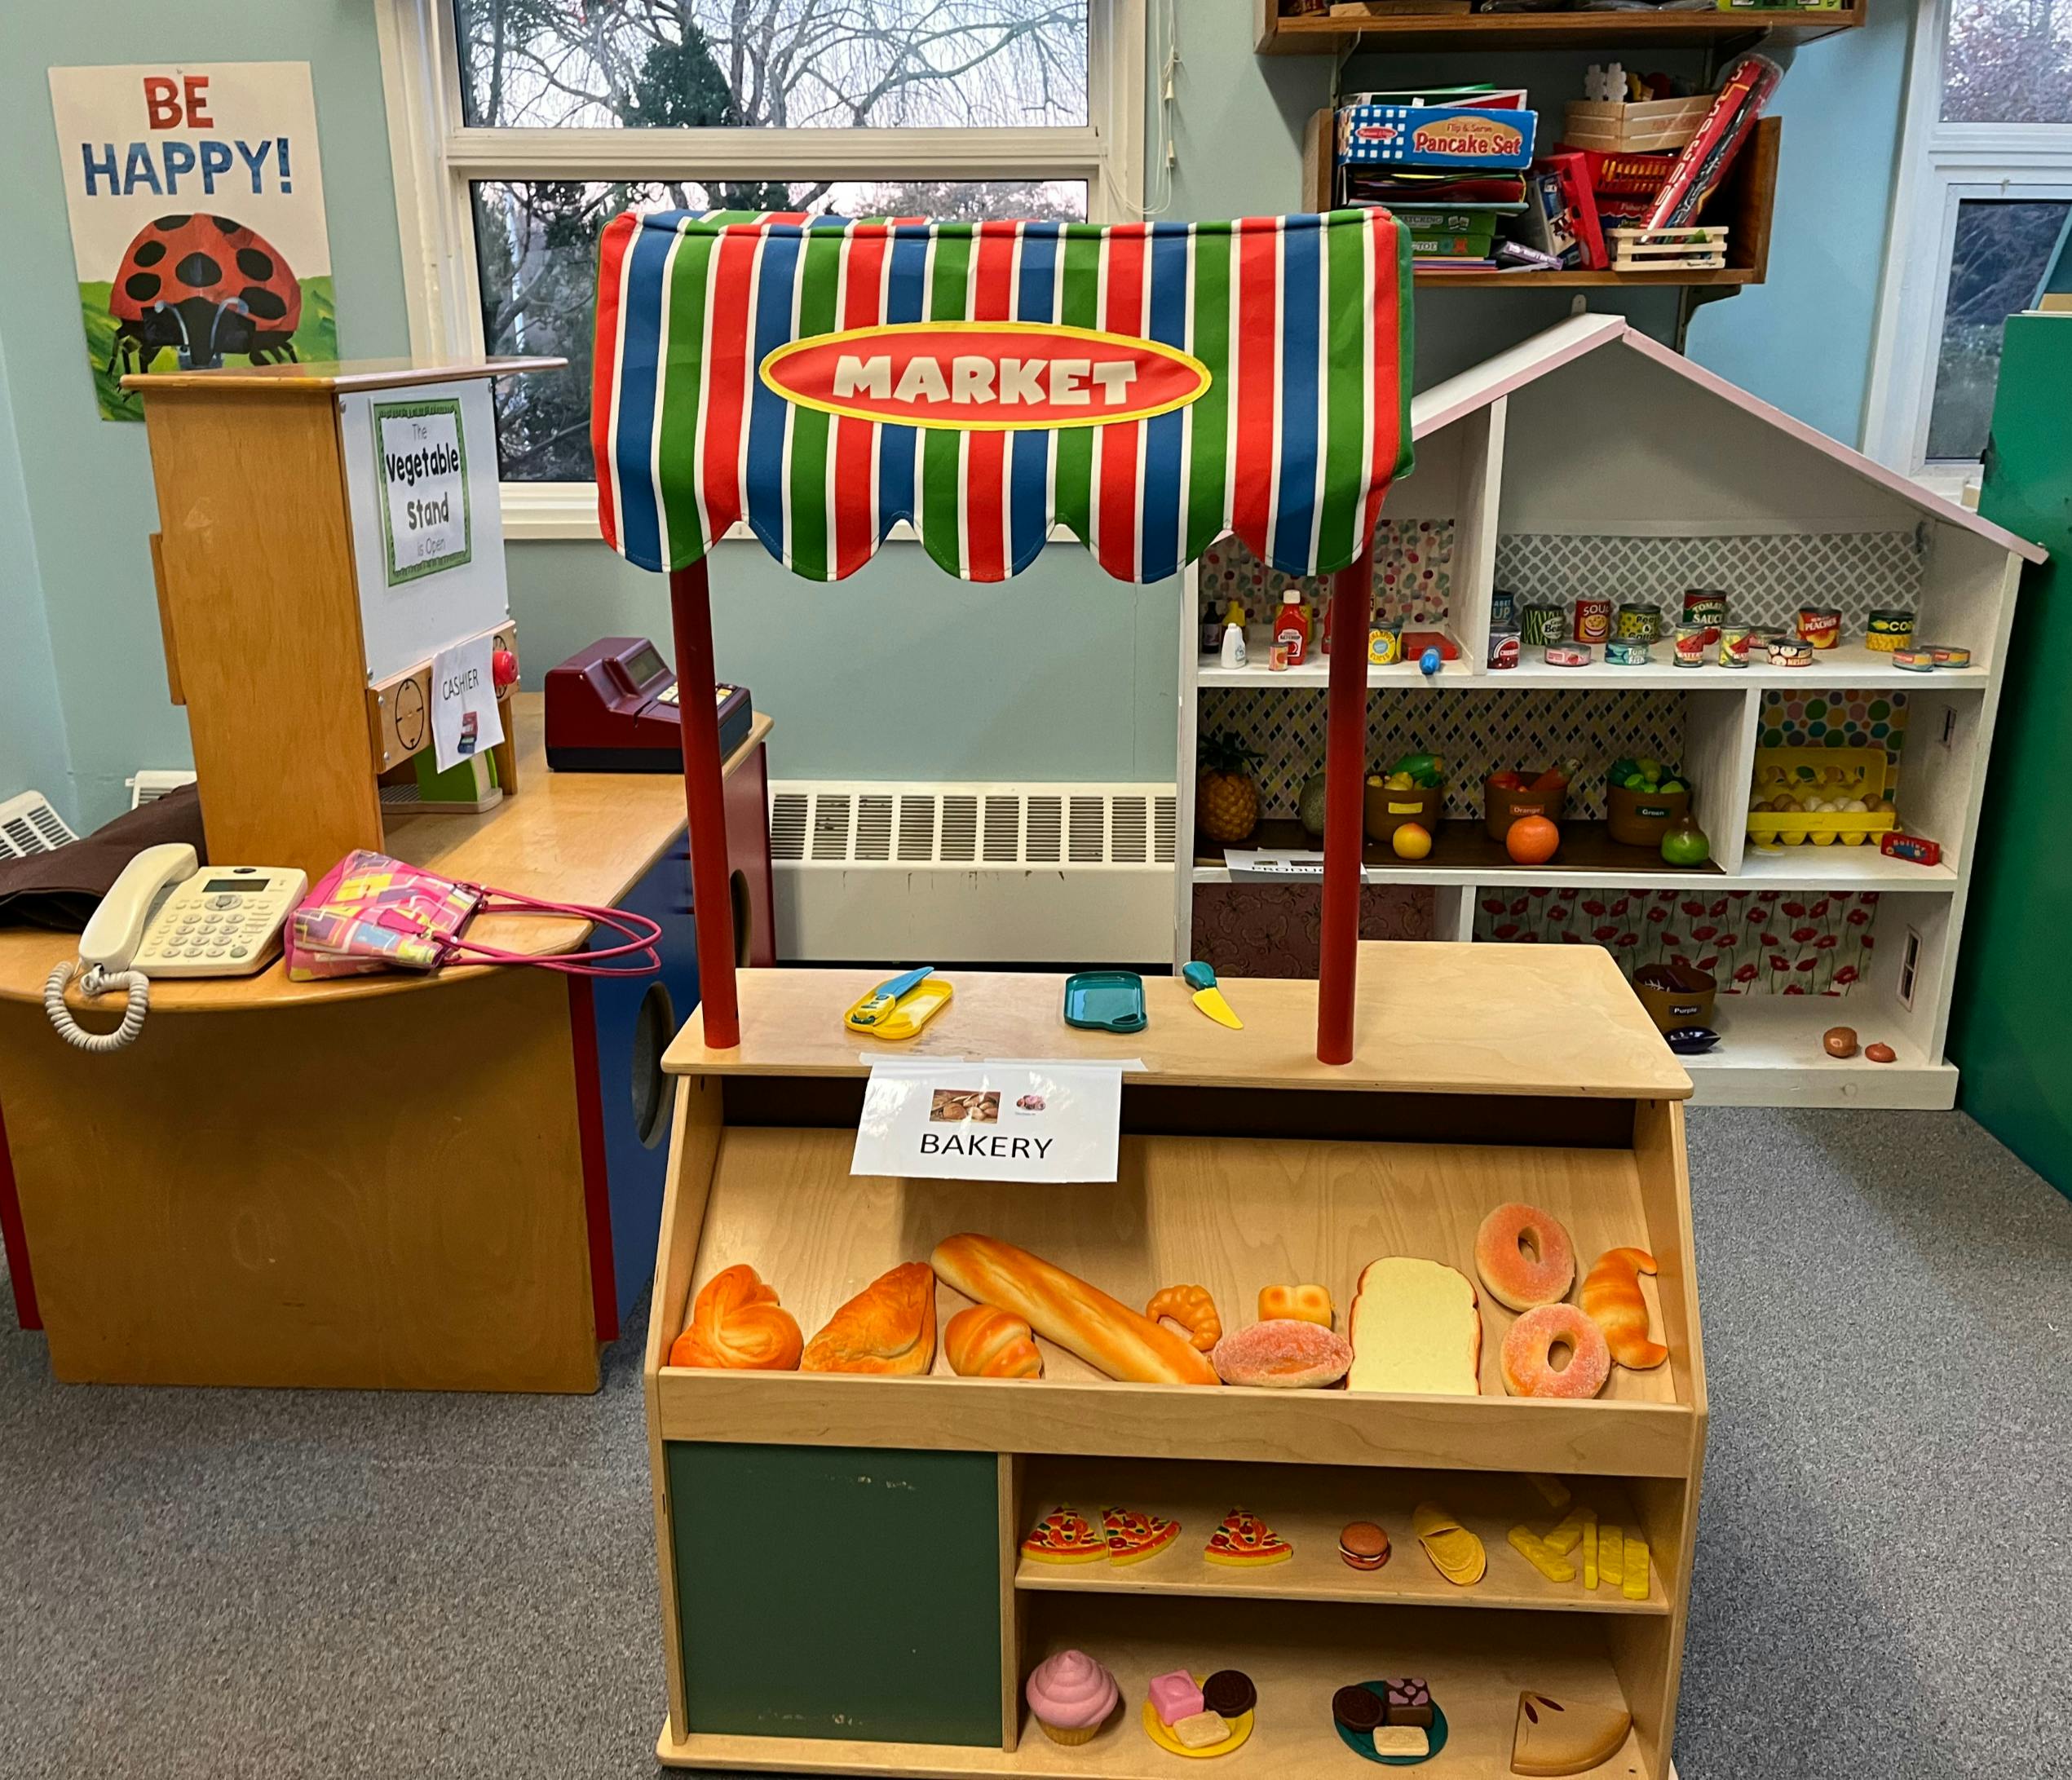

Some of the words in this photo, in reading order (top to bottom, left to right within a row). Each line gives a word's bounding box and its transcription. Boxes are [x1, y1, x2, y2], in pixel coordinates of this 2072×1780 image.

[144, 76, 214, 130] BE
[1414, 132, 1487, 152] Pancake
[1491, 135, 1522, 154] Set
[82, 138, 293, 196] HAPPY!
[833, 355, 1138, 404] MARKET
[412, 423, 427, 440] The
[386, 442, 459, 487] Vegetable
[408, 492, 448, 530] Stand
[417, 539, 424, 556] is
[426, 537, 446, 556] Open
[1493, 607, 1510, 620] UP
[1805, 617, 1836, 631] PEACHES
[442, 669, 479, 700] CASHIER
[1513, 806, 1540, 815] Orange
[920, 1133, 1054, 1159] BAKERY
